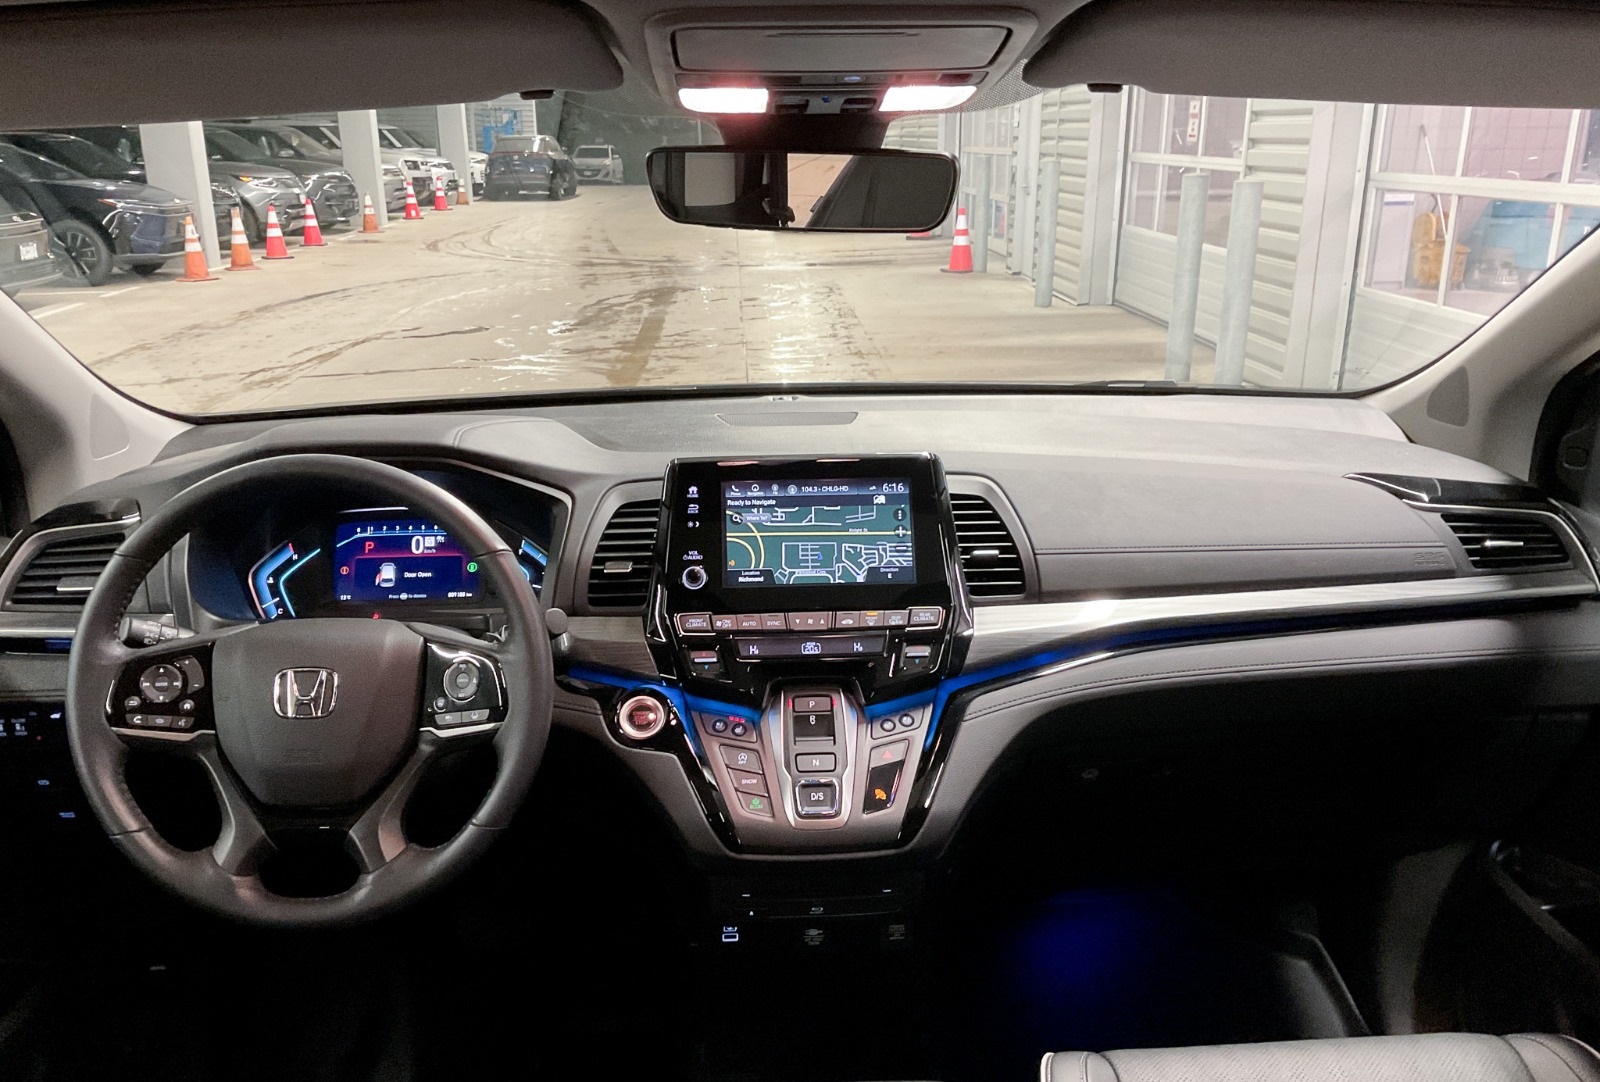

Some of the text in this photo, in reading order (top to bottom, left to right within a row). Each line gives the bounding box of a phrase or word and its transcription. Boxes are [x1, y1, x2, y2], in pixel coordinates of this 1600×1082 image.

[882, 483, 905, 493] 6:16
[365, 541, 375, 554] P
[411, 535, 424, 554] 0
[812, 759, 820, 767] N
[810, 792, 825, 801] D/S
